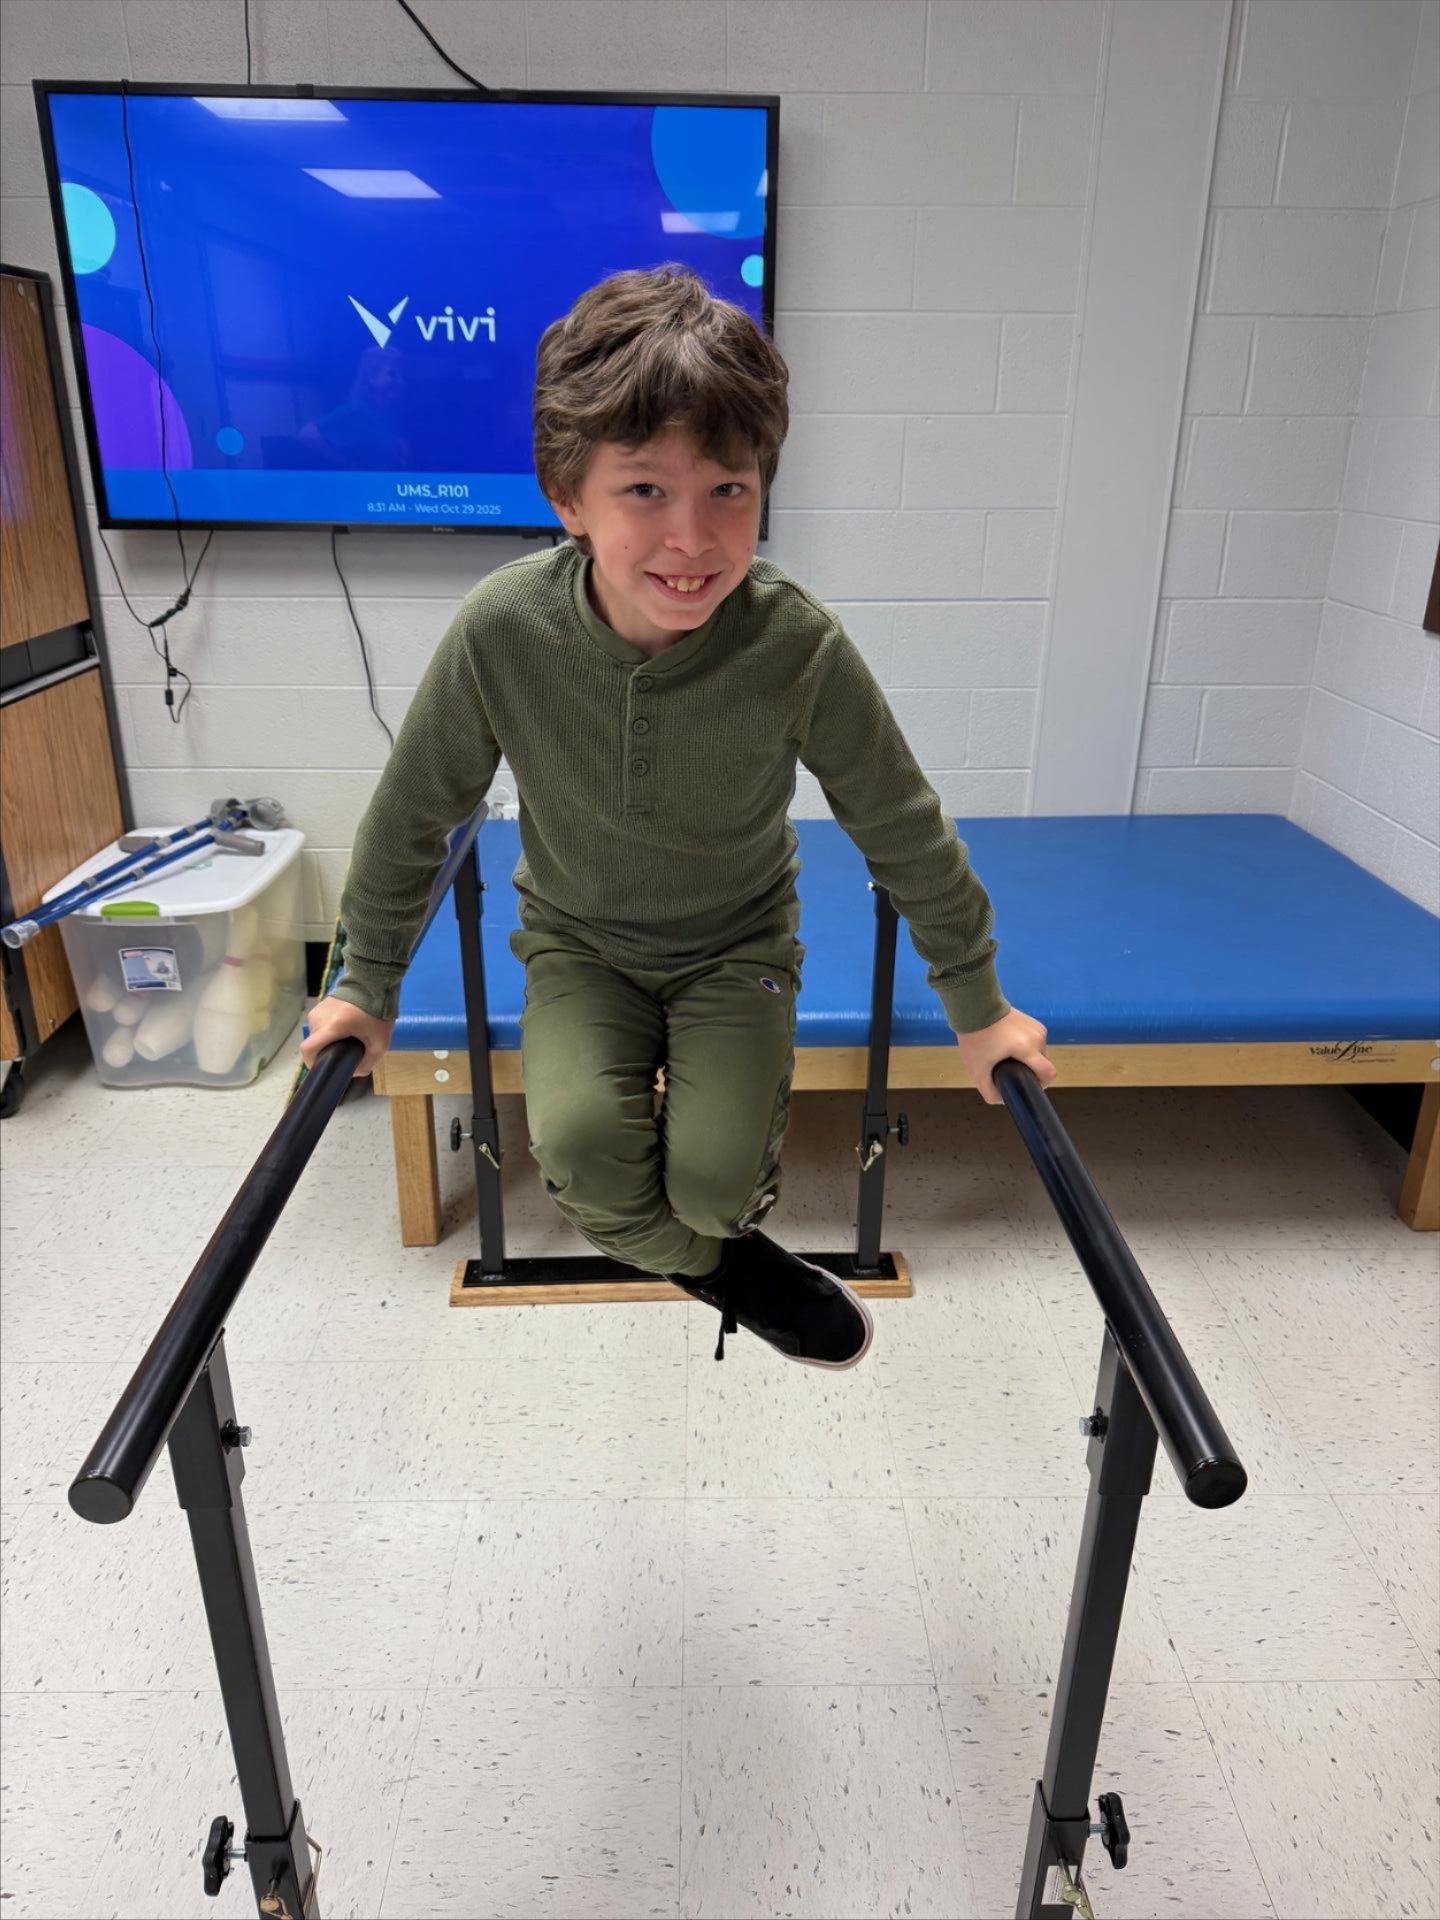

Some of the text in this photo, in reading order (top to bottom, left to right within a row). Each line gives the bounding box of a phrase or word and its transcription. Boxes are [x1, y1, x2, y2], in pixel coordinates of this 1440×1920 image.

[415, 306, 496, 342] vivi
[396, 484, 469, 498] UMS_R101
[388, 503, 406, 513] AM
[415, 504, 438, 514] Wed
[441, 504, 460, 514] Oct
[462, 504, 474, 514] 29
[476, 504, 501, 515] 2025
